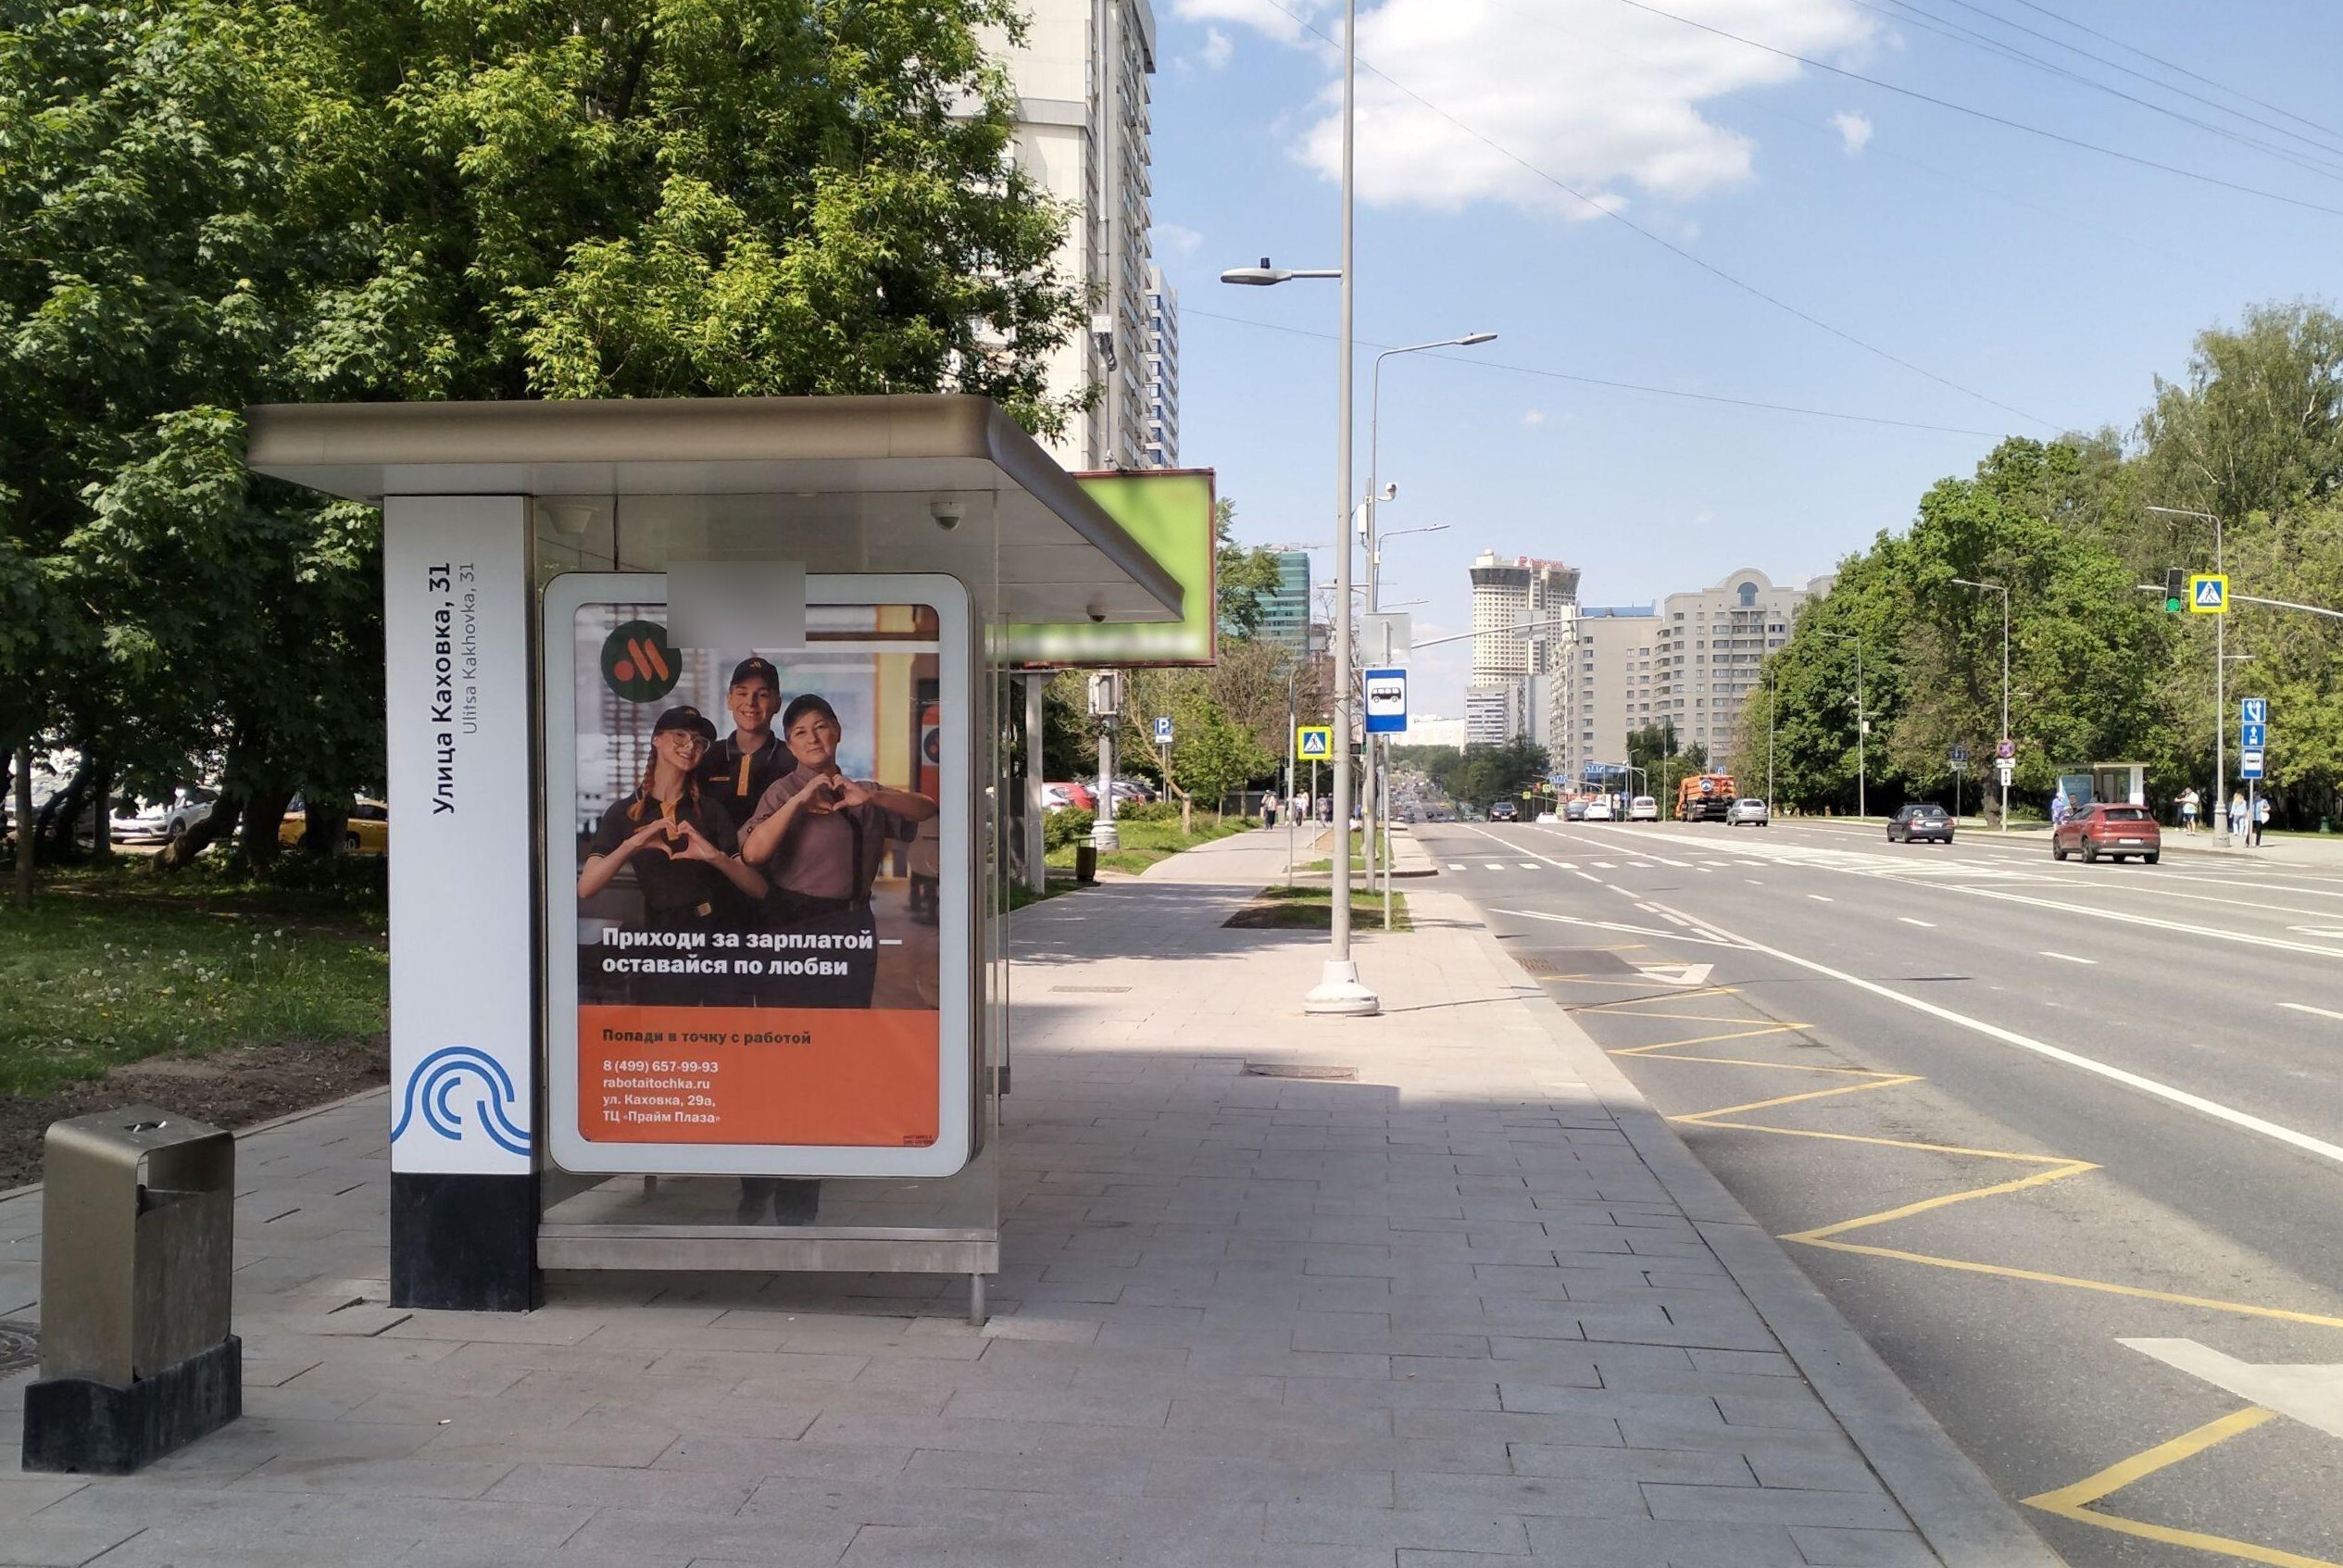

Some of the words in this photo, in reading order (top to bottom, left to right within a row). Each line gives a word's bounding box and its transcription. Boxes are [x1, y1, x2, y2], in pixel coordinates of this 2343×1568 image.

[429, 562, 451, 593] 31
[459, 562, 474, 583] 31
[460, 588, 478, 680] Kakhovka,
[431, 602, 455, 722] Каховка,
[462, 685, 478, 734] Ulitsa
[432, 733, 456, 814] Улица
[602, 927, 706, 950] Приходи
[711, 933, 740, 947] за
[746, 929, 873, 952] зарплатой
[602, 953, 728, 974] оставайся
[733, 960, 763, 975] по
[768, 957, 848, 975] любви
[602, 1028, 663, 1044] Попади
[668, 1033, 677, 1042] в
[681, 1033, 727, 1046] точку
[731, 1033, 739, 1043] с
[744, 1030, 811, 1046] работой
[603, 1060, 612, 1072] 8
[614, 1060, 649, 1073] (499)
[652, 1060, 719, 1073] 657-99-93
[603, 1077, 710, 1089] rabotaitochka.ru
[602, 1095, 621, 1107] ул.
[624, 1094, 683, 1107] Каховка,
[602, 1110, 620, 1123] ТЦ
